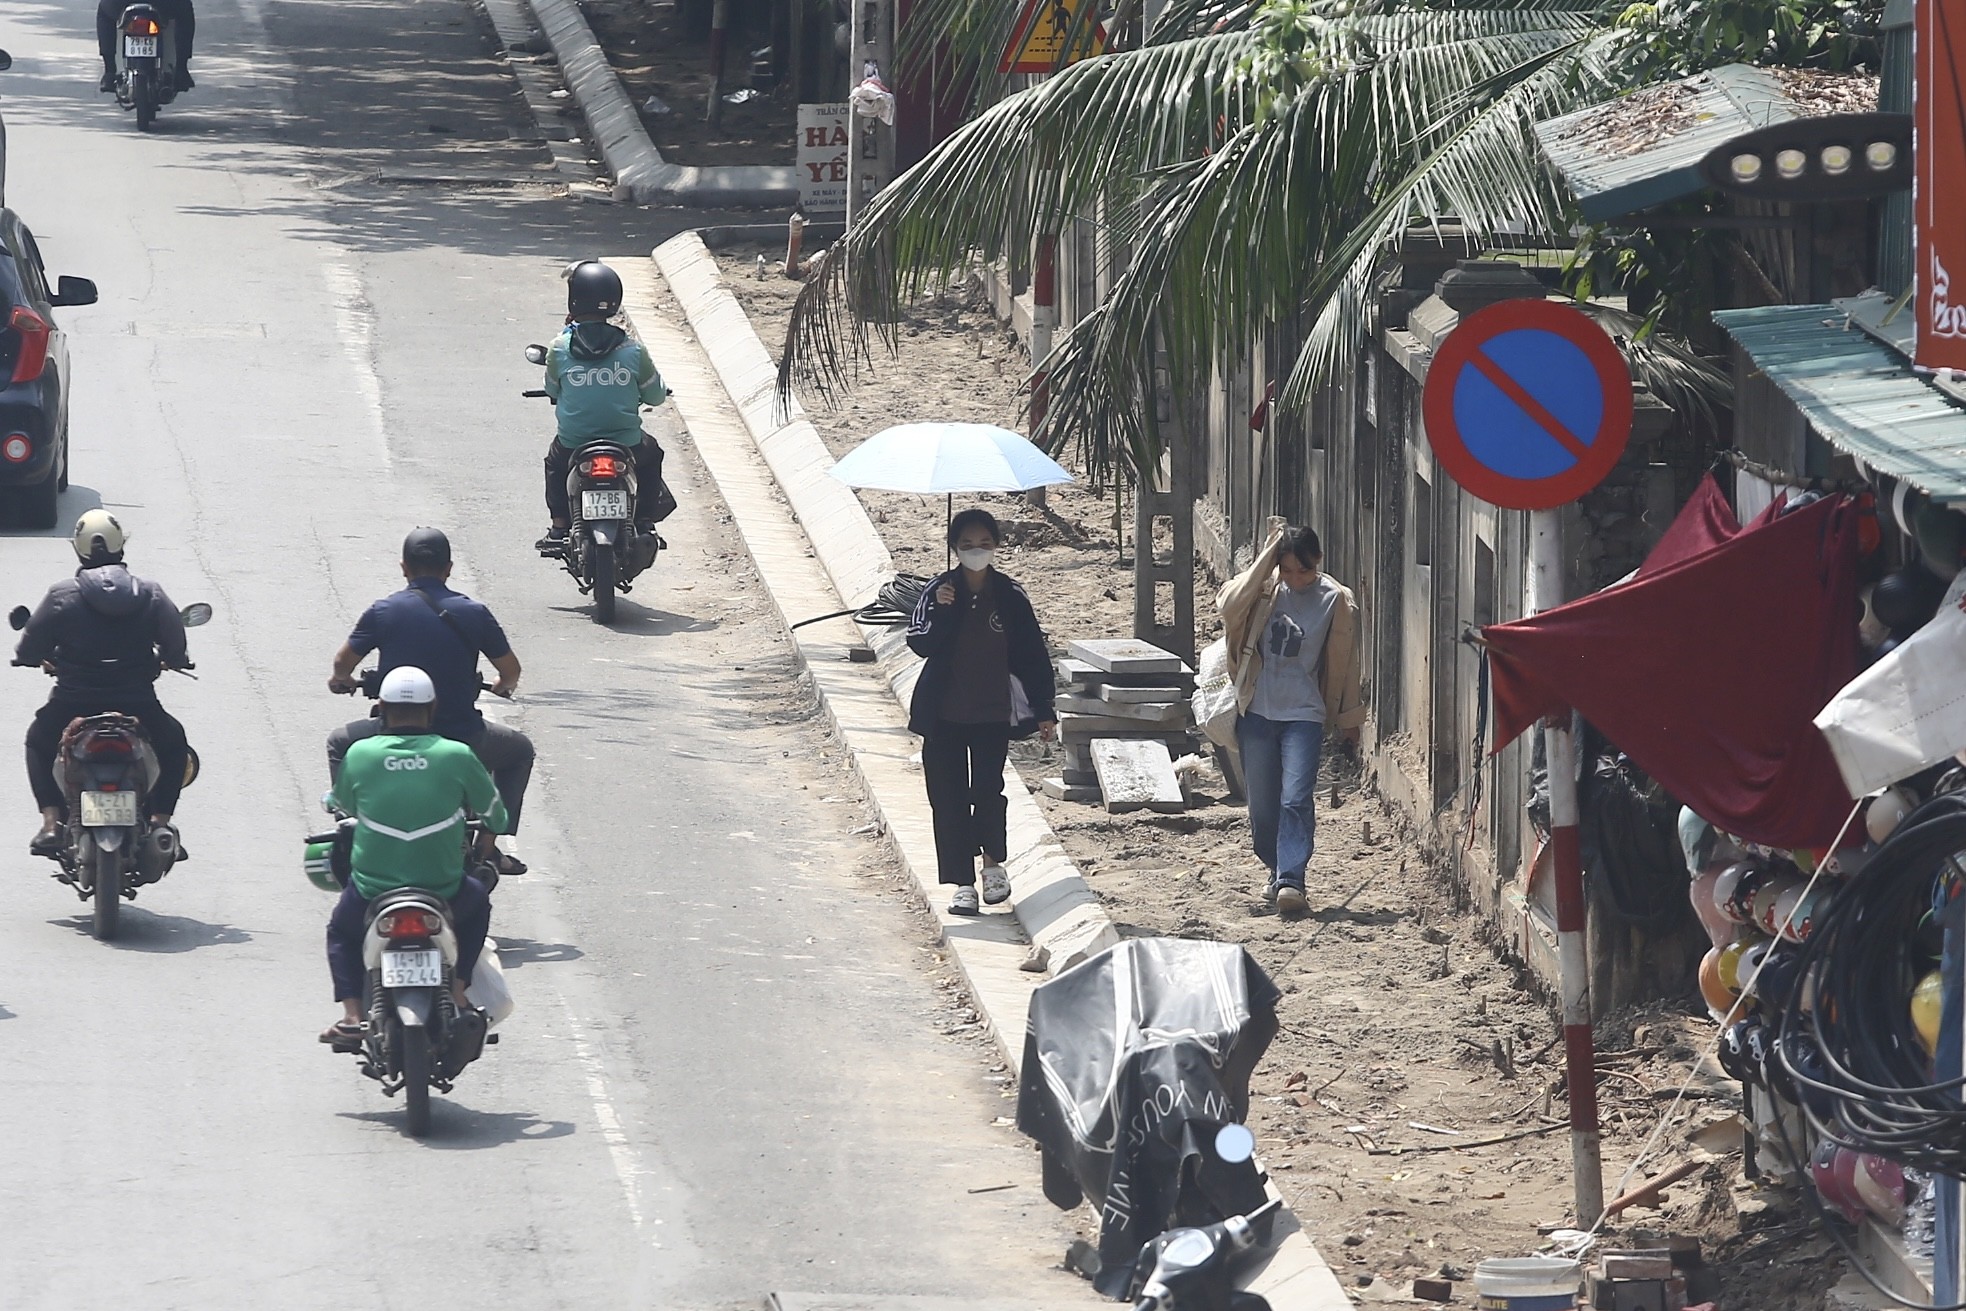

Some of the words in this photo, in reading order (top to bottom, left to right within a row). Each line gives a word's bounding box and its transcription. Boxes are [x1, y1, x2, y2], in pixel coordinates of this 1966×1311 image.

[566, 361, 631, 387] Grab
[590, 493, 620, 505] 17-B6
[383, 754, 428, 771] Grab
[89, 793, 127, 808] 14-Z1
[392, 952, 431, 968] 14-U1
